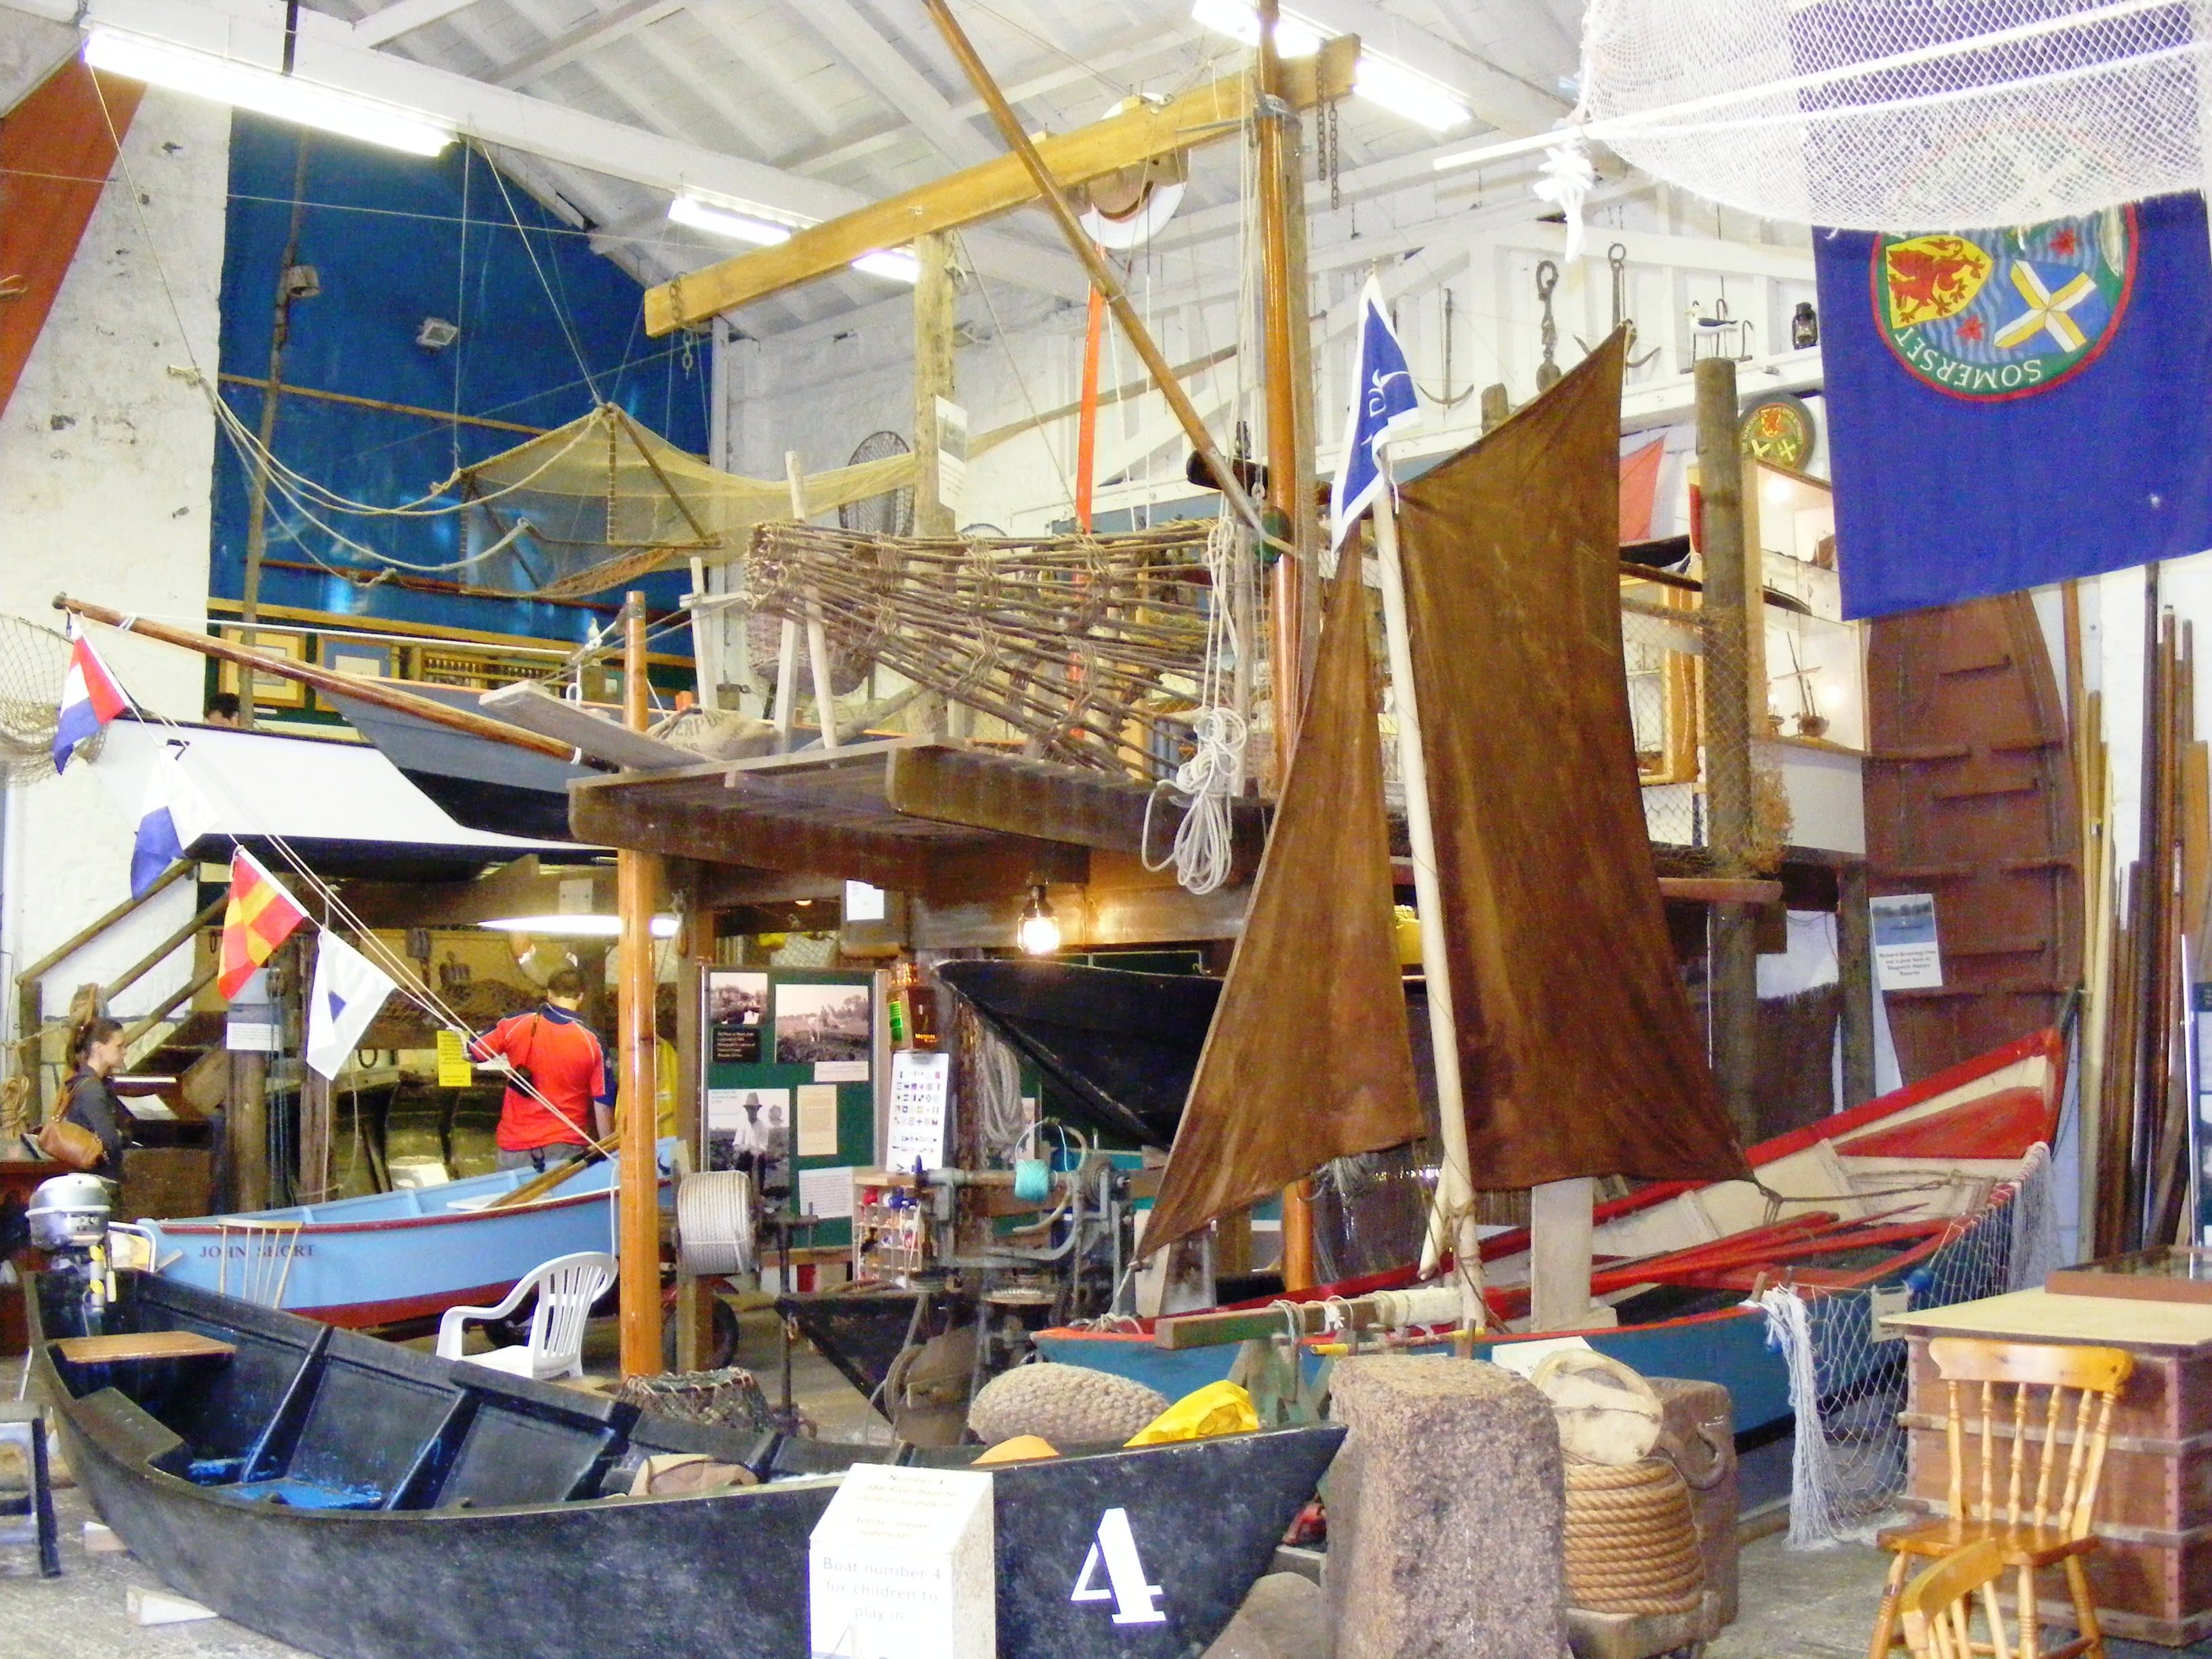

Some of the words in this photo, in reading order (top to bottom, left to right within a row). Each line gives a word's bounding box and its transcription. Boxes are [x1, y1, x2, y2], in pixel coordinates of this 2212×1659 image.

[1894, 327, 2042, 390] SOMERSET
[201, 1246, 248, 1258] JOHN
[257, 1244, 316, 1258] SHORT
[823, 1557, 859, 1573] Boat
[864, 1564, 927, 1579] number
[932, 1567, 941, 1580] 4
[1070, 1507, 1167, 1624] 4
[825, 1579, 847, 1594] for
[852, 1582, 916, 1600] children
[922, 1591, 939, 1603] to
[854, 1605, 884, 1622] play
